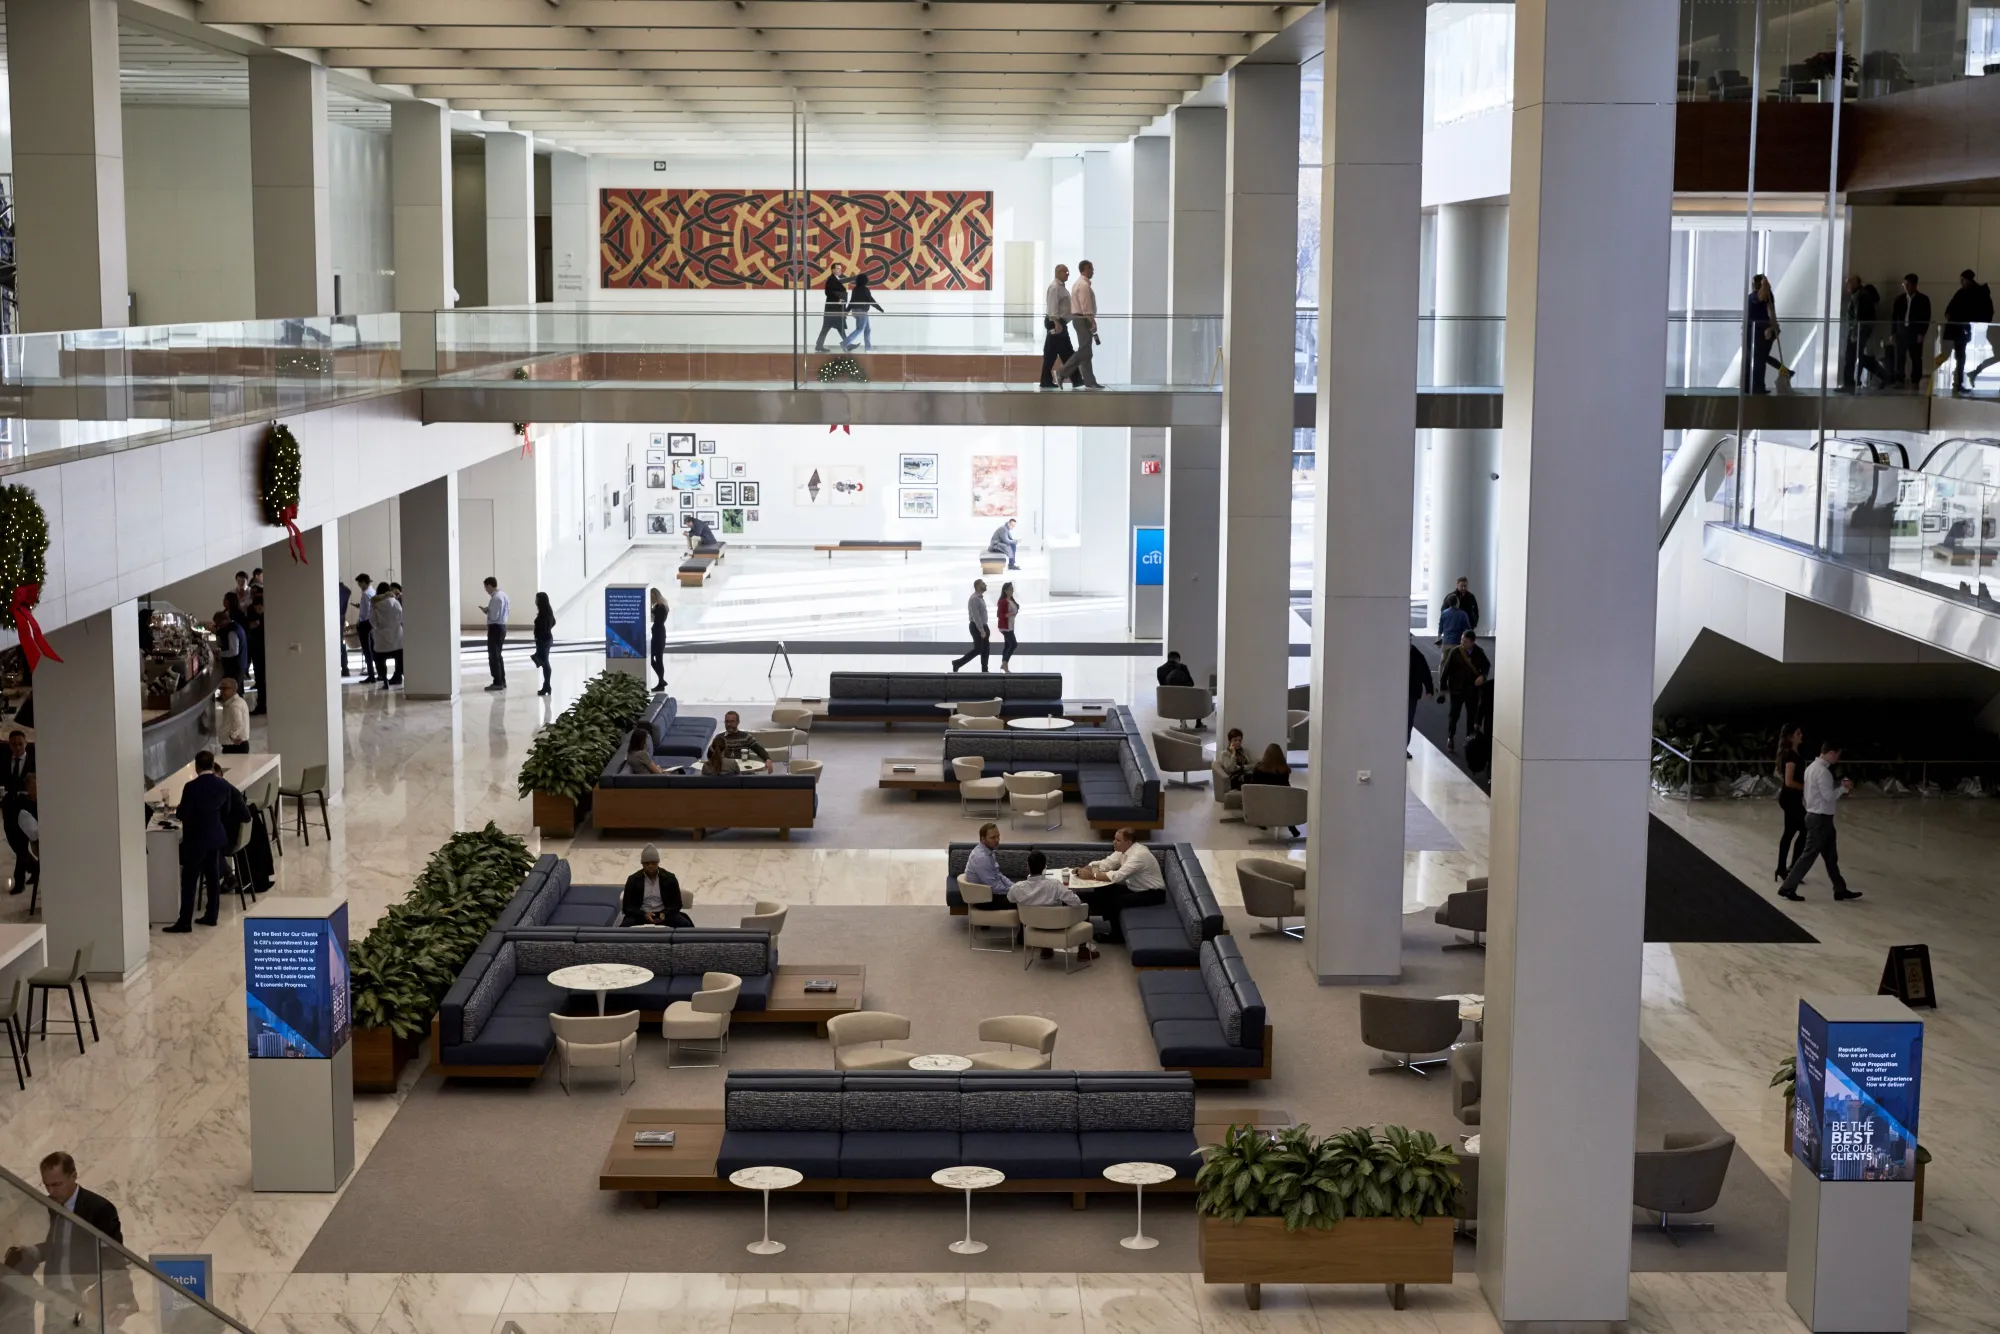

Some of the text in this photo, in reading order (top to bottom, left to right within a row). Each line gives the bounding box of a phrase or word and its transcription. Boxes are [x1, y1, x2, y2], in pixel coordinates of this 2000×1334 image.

[1142, 551, 1162, 564] citi
[1832, 1121, 1874, 1131] BE THE
[1832, 1132, 1874, 1144] BEST
[1831, 1144, 1873, 1152] FOR OUR
[170, 1275, 197, 1284] atch
